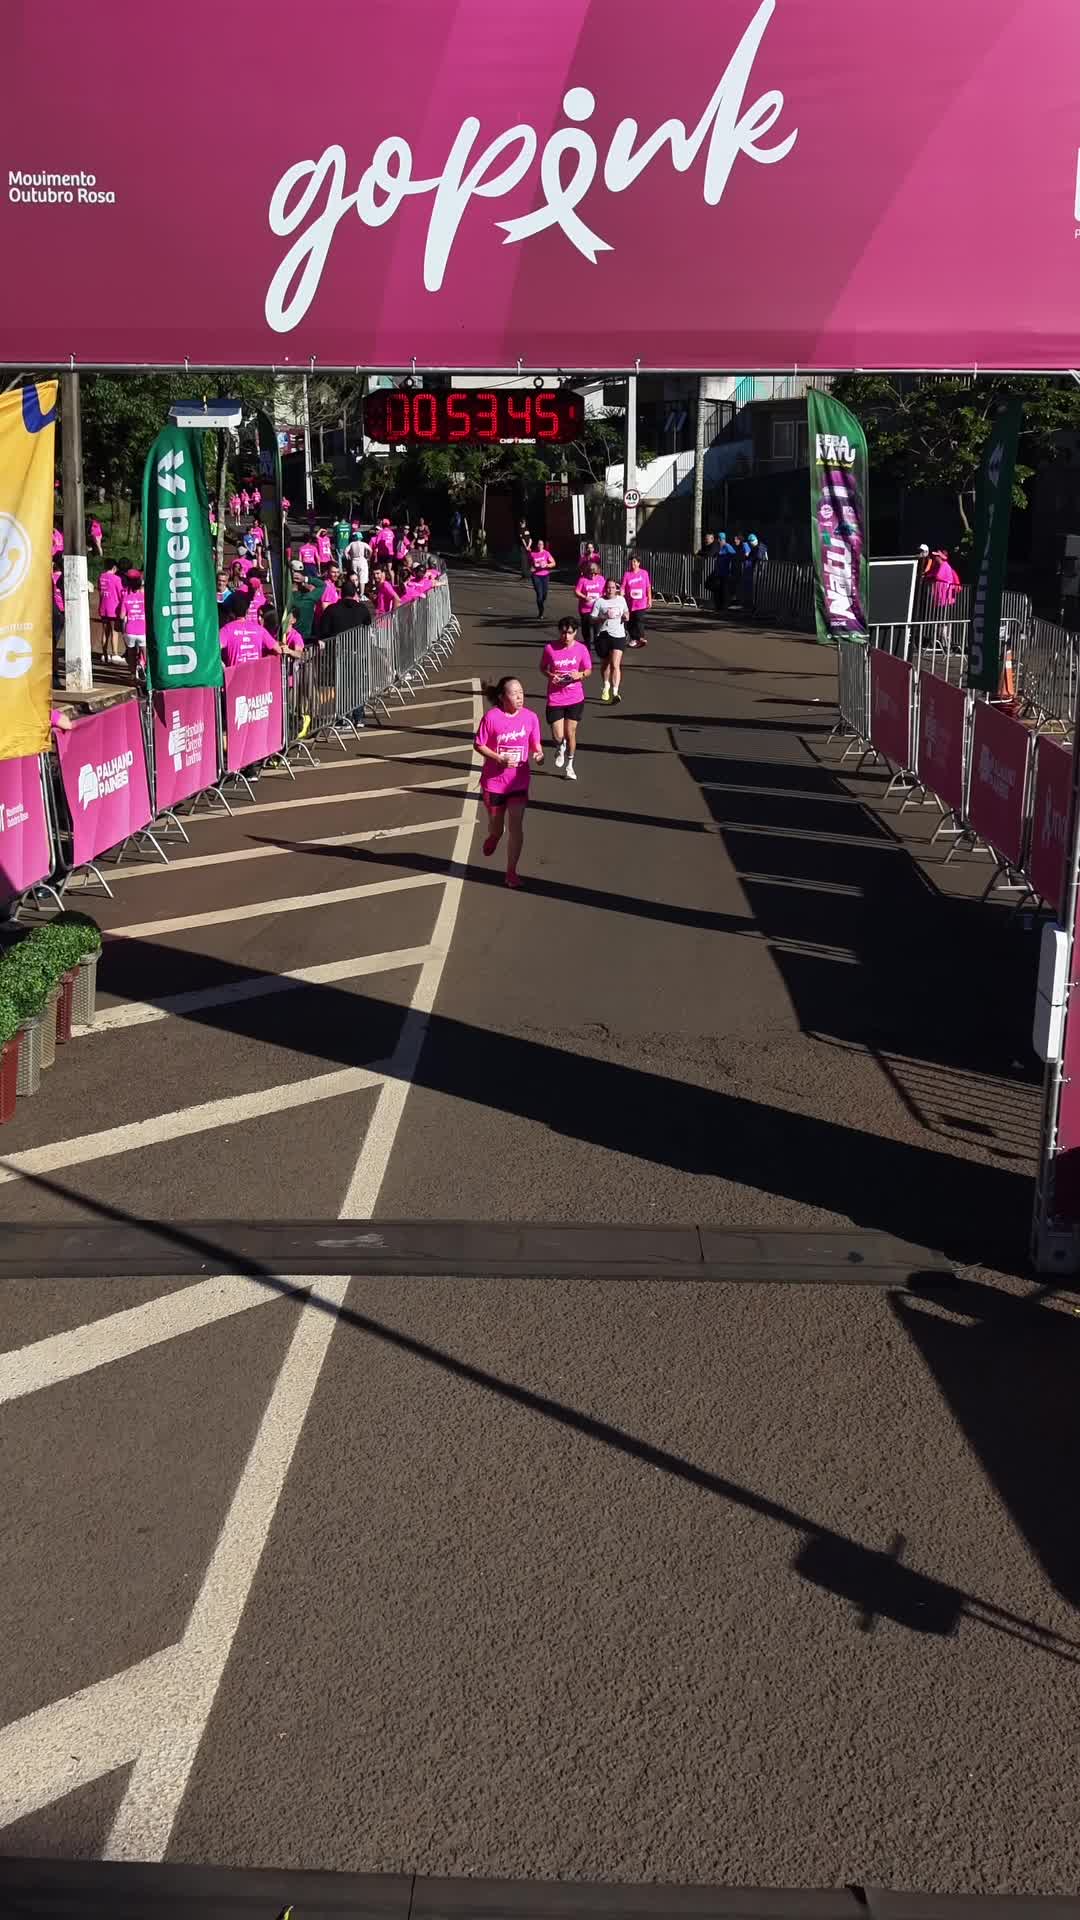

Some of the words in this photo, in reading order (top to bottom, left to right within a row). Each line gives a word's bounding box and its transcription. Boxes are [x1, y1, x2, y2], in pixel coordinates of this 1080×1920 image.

[8, 187, 74, 203] Outubro
[77, 188, 116, 203] Rosa
[816, 434, 849, 447] BEBA
[816, 445, 857, 462] NATU
[626, 493, 638, 501] 40
[158, 506, 199, 676] Unimed
[96, 750, 134, 781] PALHANO
